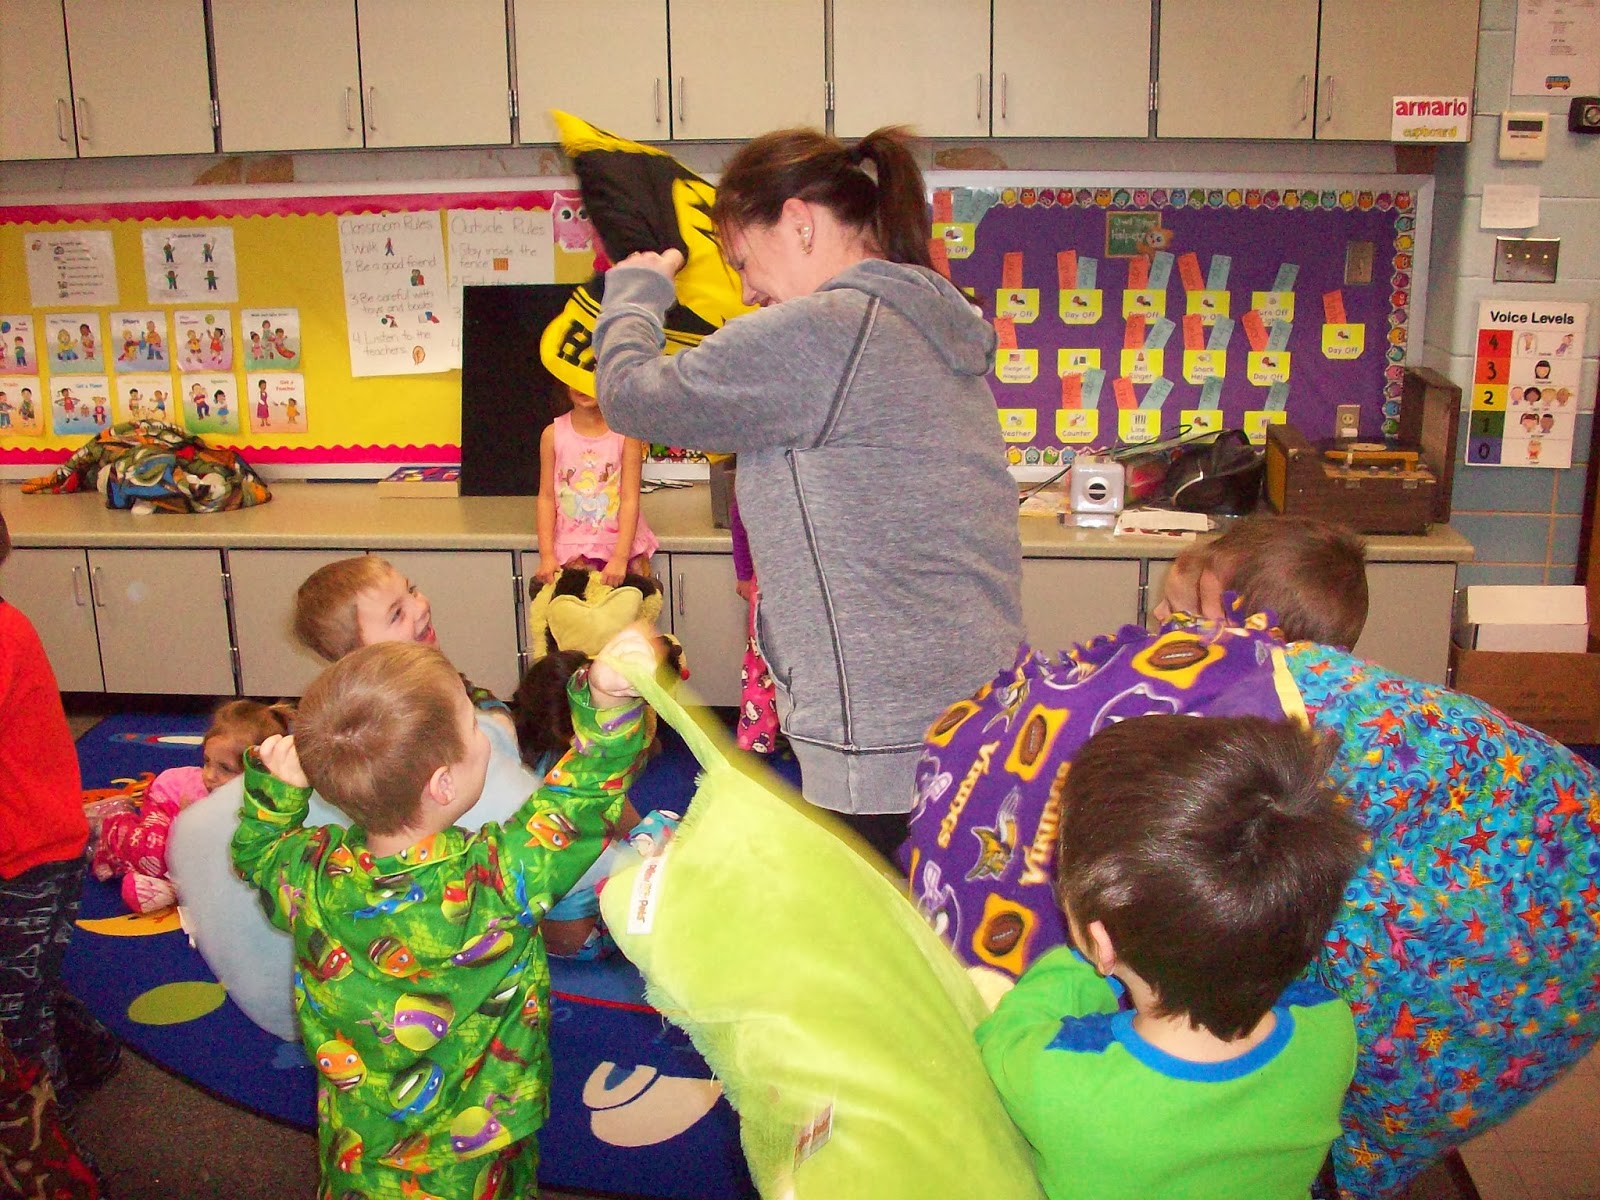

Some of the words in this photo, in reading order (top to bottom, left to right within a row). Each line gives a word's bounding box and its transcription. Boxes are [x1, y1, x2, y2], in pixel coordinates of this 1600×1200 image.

[1395, 97, 1468, 117] armario
[1402, 124, 1458, 139] cupboard
[341, 219, 400, 235] Classroom
[404, 215, 433, 231] Rules
[451, 215, 504, 235] Outside
[512, 216, 546, 236] Rules
[519, 243, 537, 257] the
[954, 245, 969, 254] Off
[381, 257, 404, 275] good
[387, 302, 405, 312] and
[1020, 310, 1034, 318] Off
[1082, 311, 1096, 319] Off
[1489, 310, 1528, 323] Voice
[1531, 311, 1575, 325] Levels
[1488, 334, 1499, 350] 4
[1328, 346, 1343, 355] Day
[1345, 346, 1358, 354] Off
[1134, 364, 1148, 372] Bell
[1486, 361, 1497, 380] 3
[1191, 373, 1208, 381] Help
[1253, 373, 1268, 381] Day
[1270, 373, 1284, 381] Off
[1483, 390, 1494, 405] 2
[1483, 418, 1490, 433] 1
[1062, 430, 1092, 438] Counter
[1479, 442, 1490, 460] 0
